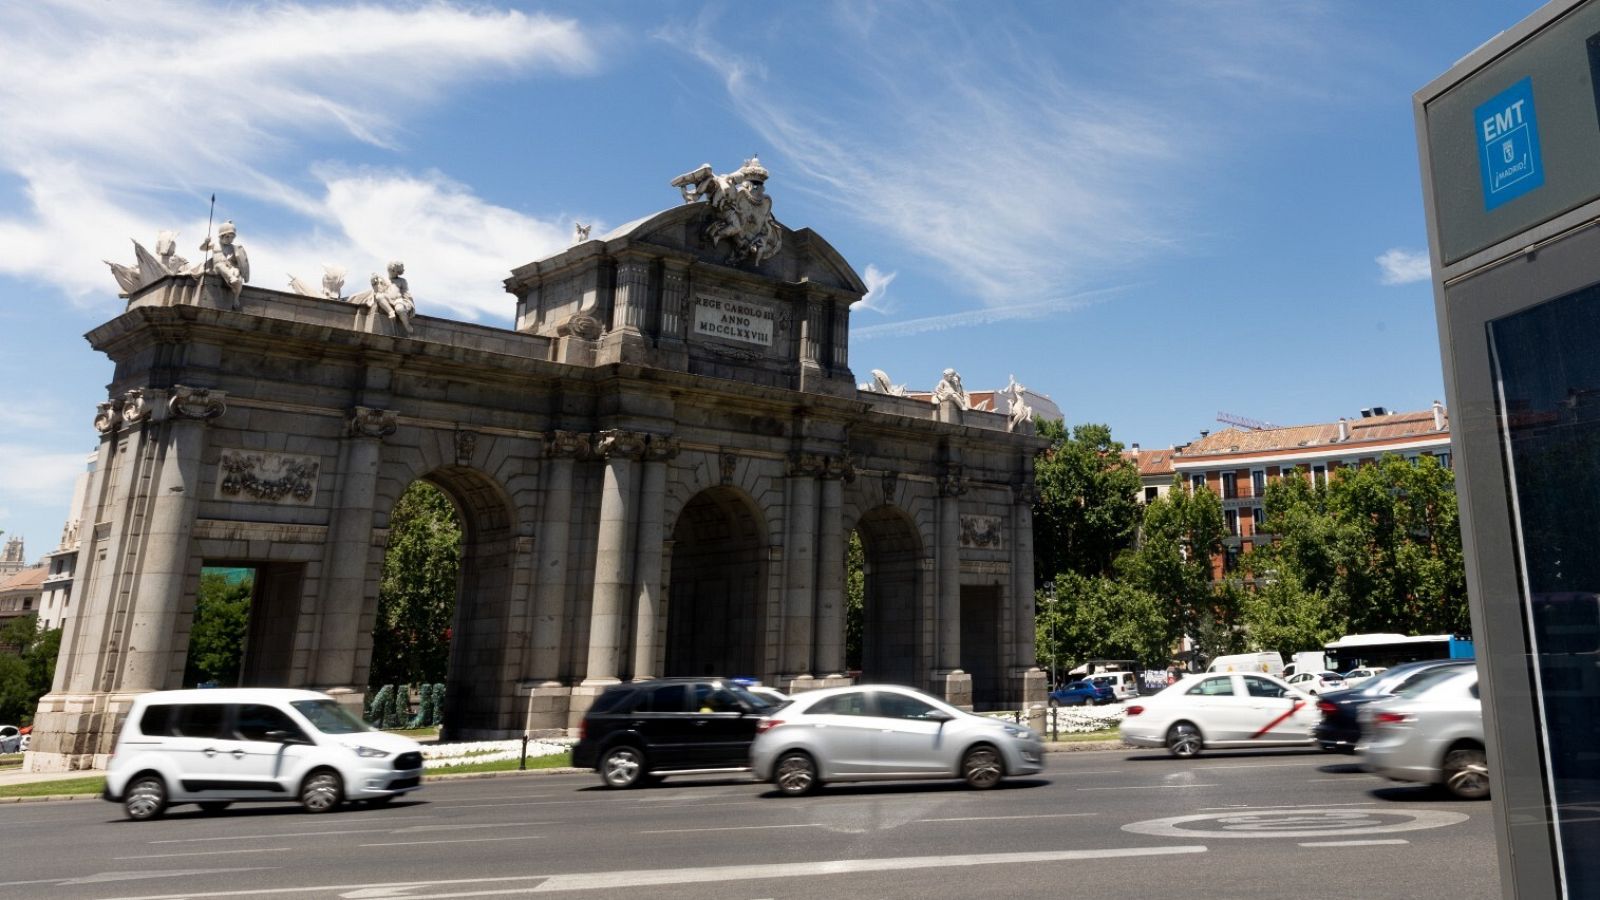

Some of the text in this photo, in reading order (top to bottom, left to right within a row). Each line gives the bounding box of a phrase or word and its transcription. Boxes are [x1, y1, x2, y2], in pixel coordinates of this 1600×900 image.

[1483, 99, 1525, 142] EMT
[695, 297, 774, 320] REGE CAROLO III
[700, 321, 768, 342] MDCCLXXVIII
[721, 315, 750, 327] ANNO
